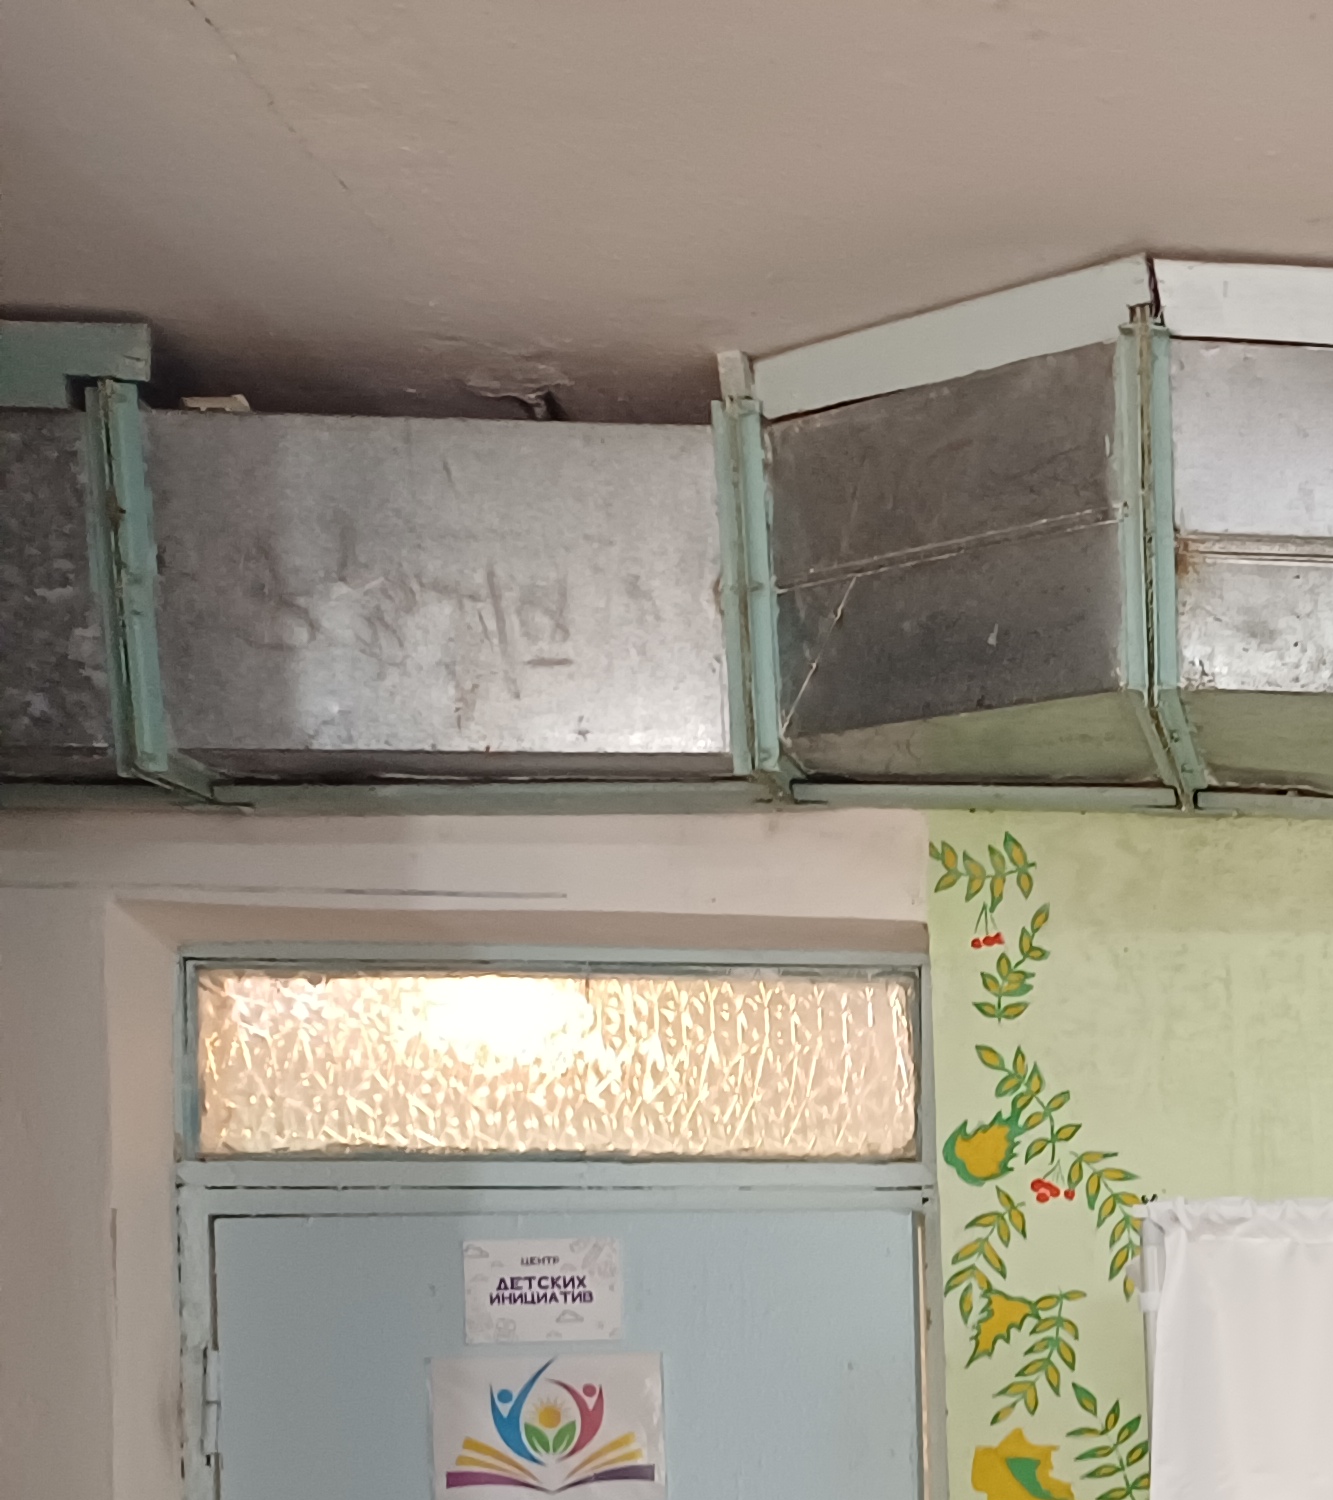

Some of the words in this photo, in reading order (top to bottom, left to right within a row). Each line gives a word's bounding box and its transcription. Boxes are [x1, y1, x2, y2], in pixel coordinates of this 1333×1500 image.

[520, 1255, 560, 1267] ЦЕНТР
[496, 1275, 588, 1292] ДЕТСКИХ
[489, 1290, 594, 1306] ИНИЦИАТИВ
